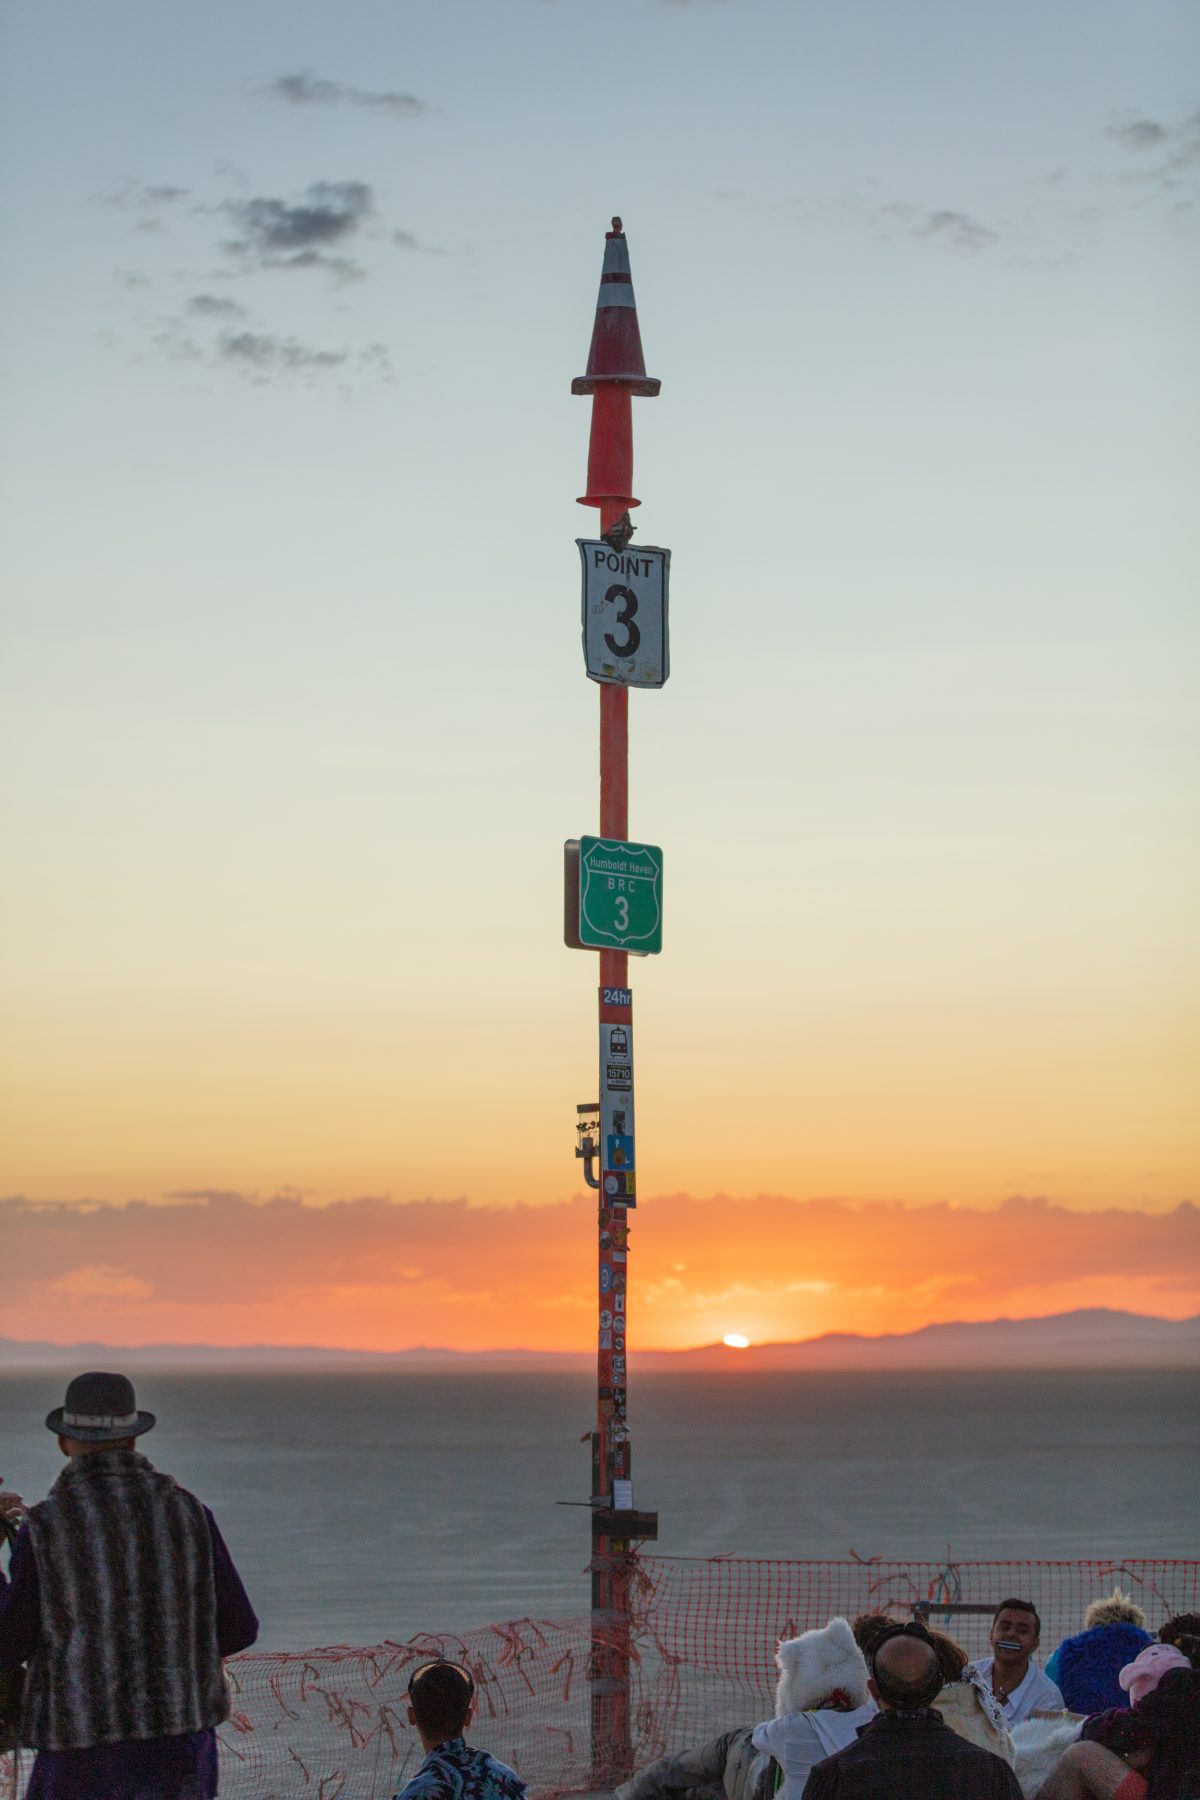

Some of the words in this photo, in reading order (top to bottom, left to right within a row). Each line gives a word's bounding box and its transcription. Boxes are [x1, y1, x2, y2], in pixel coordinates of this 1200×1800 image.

[594, 550, 654, 578] POINT
[603, 584, 641, 658] 3
[590, 856, 627, 871] Humboldt
[629, 862, 653, 875] Haven
[613, 896, 629, 931] 3
[604, 990, 631, 1004] 24hr
